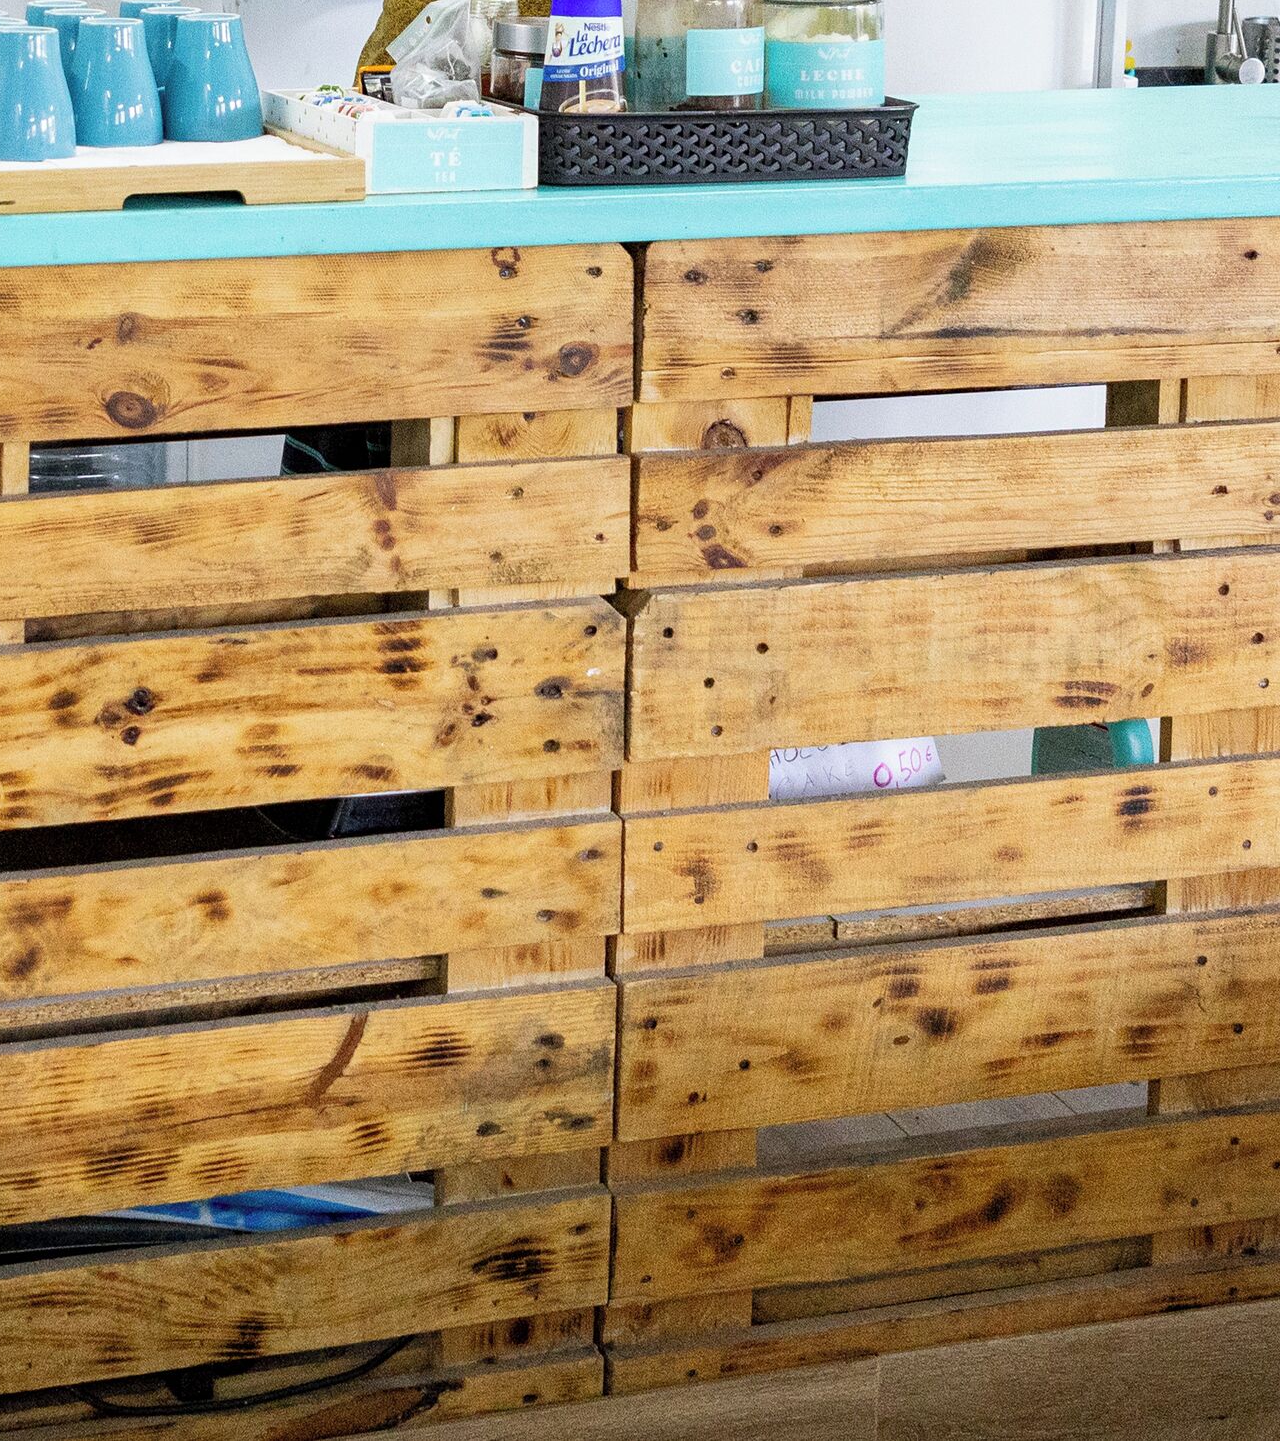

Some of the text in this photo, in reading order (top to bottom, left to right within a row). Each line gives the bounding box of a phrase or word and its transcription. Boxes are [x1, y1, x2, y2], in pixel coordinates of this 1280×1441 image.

[577, 31, 588, 43] La
[800, 69, 865, 82] LECHE
[430, 147, 462, 167] TÉ
[435, 172, 456, 183] TEA
